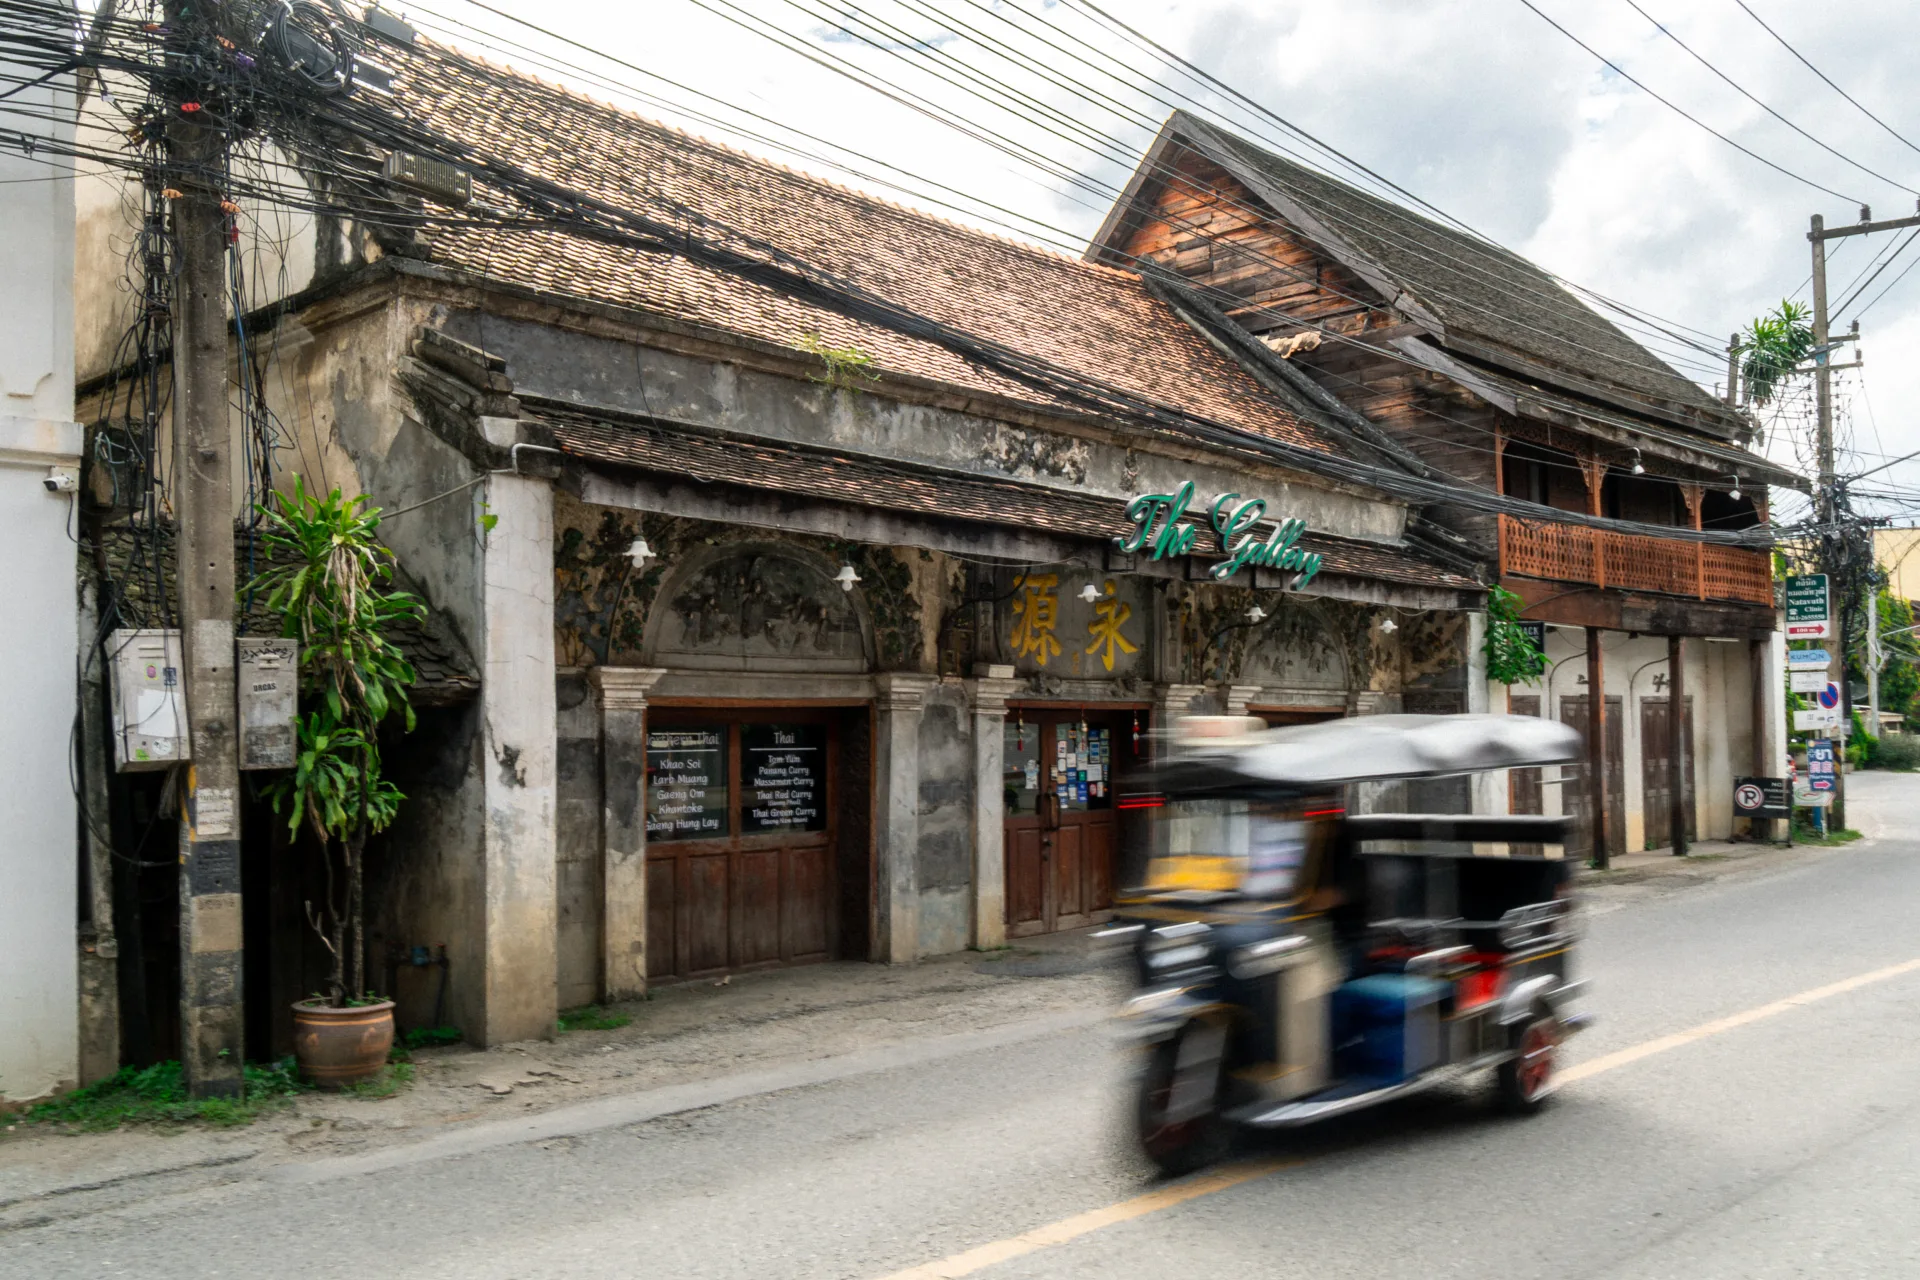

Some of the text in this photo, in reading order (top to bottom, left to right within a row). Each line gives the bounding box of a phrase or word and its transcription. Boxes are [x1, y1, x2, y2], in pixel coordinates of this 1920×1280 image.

[1112, 480, 1324, 591] The Gallery
[1788, 597, 1825, 605] Natavuth
[697, 731, 719, 745] Thai
[773, 730, 795, 744] Thai
[660, 759, 701, 769] Khao Soi
[768, 755, 783, 763] Tom
[759, 766, 809, 776] Panang Curry
[653, 774, 708, 785] Larb Muang
[754, 777, 814, 787] Massaman Curry
[657, 788, 705, 801] Gaeng Om
[756, 789, 812, 800] Thai Red Curry
[659, 802, 704, 814] Khantoke
[752, 807, 816, 818] Thai Green Curry
[676, 819, 700, 830] Hung
[702, 818, 719, 829] Lay
